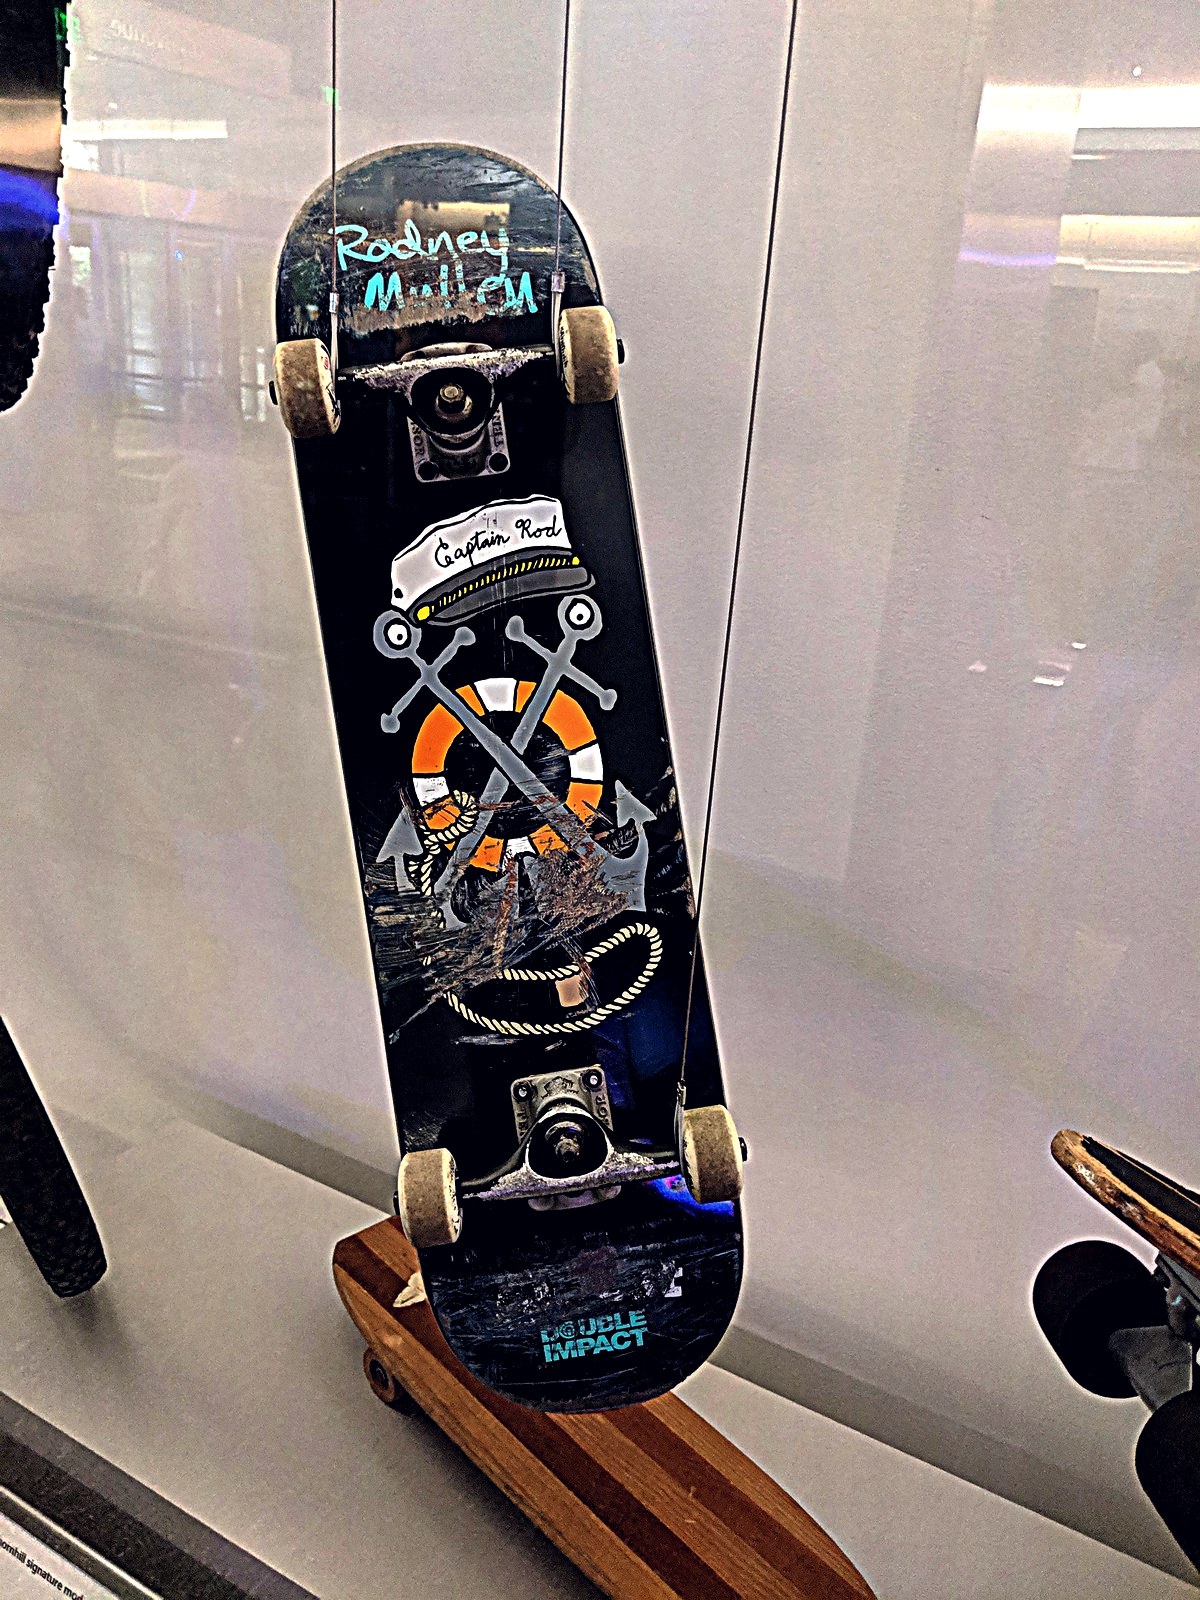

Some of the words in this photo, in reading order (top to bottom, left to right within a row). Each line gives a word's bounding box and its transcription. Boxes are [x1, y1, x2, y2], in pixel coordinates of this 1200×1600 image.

[328, 219, 511, 271] Rodney
[434, 530, 511, 567] Captain
[515, 515, 563, 538] Rod
[540, 1309, 648, 1343] DOUBLE
[543, 1327, 649, 1363] IMPACT
[26, 1559, 63, 1591] signature
